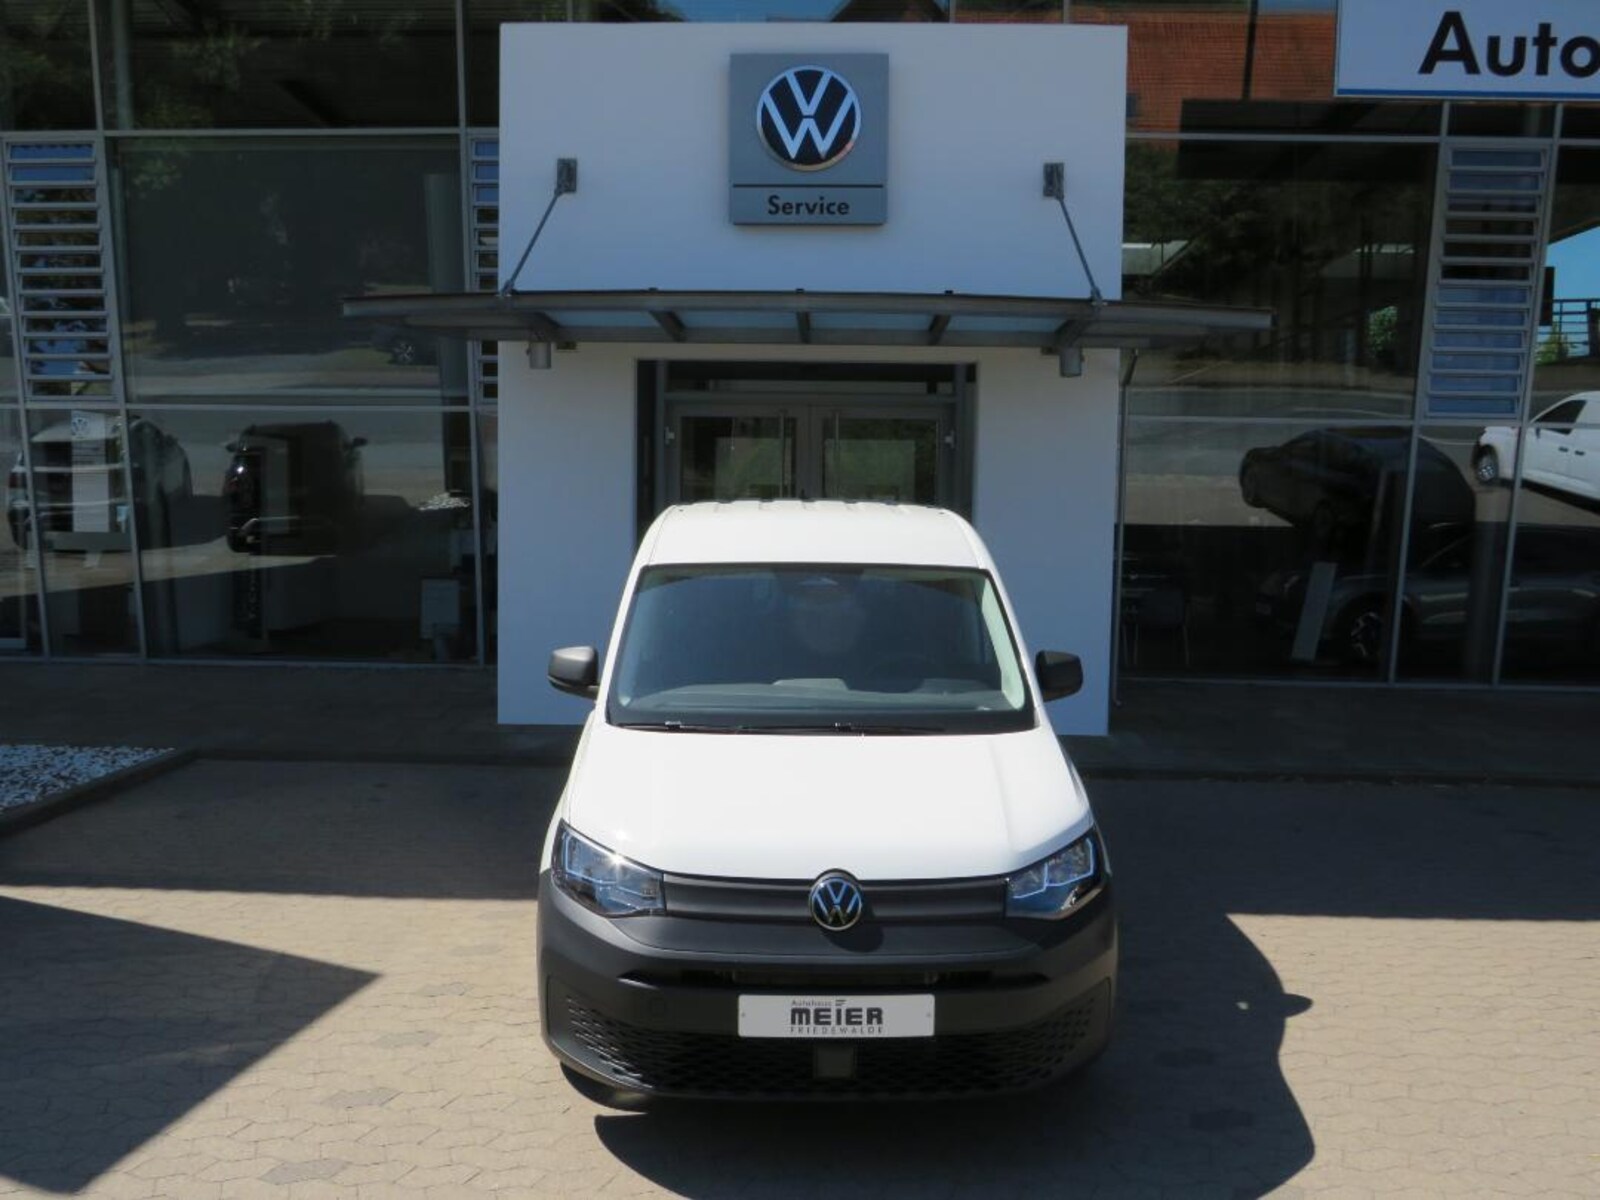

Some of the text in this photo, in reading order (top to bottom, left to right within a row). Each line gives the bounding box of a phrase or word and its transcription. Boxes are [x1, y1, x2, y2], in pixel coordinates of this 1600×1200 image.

[1418, 10, 1600, 78] Auto
[759, 67, 859, 167] VW
[767, 195, 850, 215] Service
[812, 876, 862, 929] VW
[791, 1007, 882, 1026] MEIER
